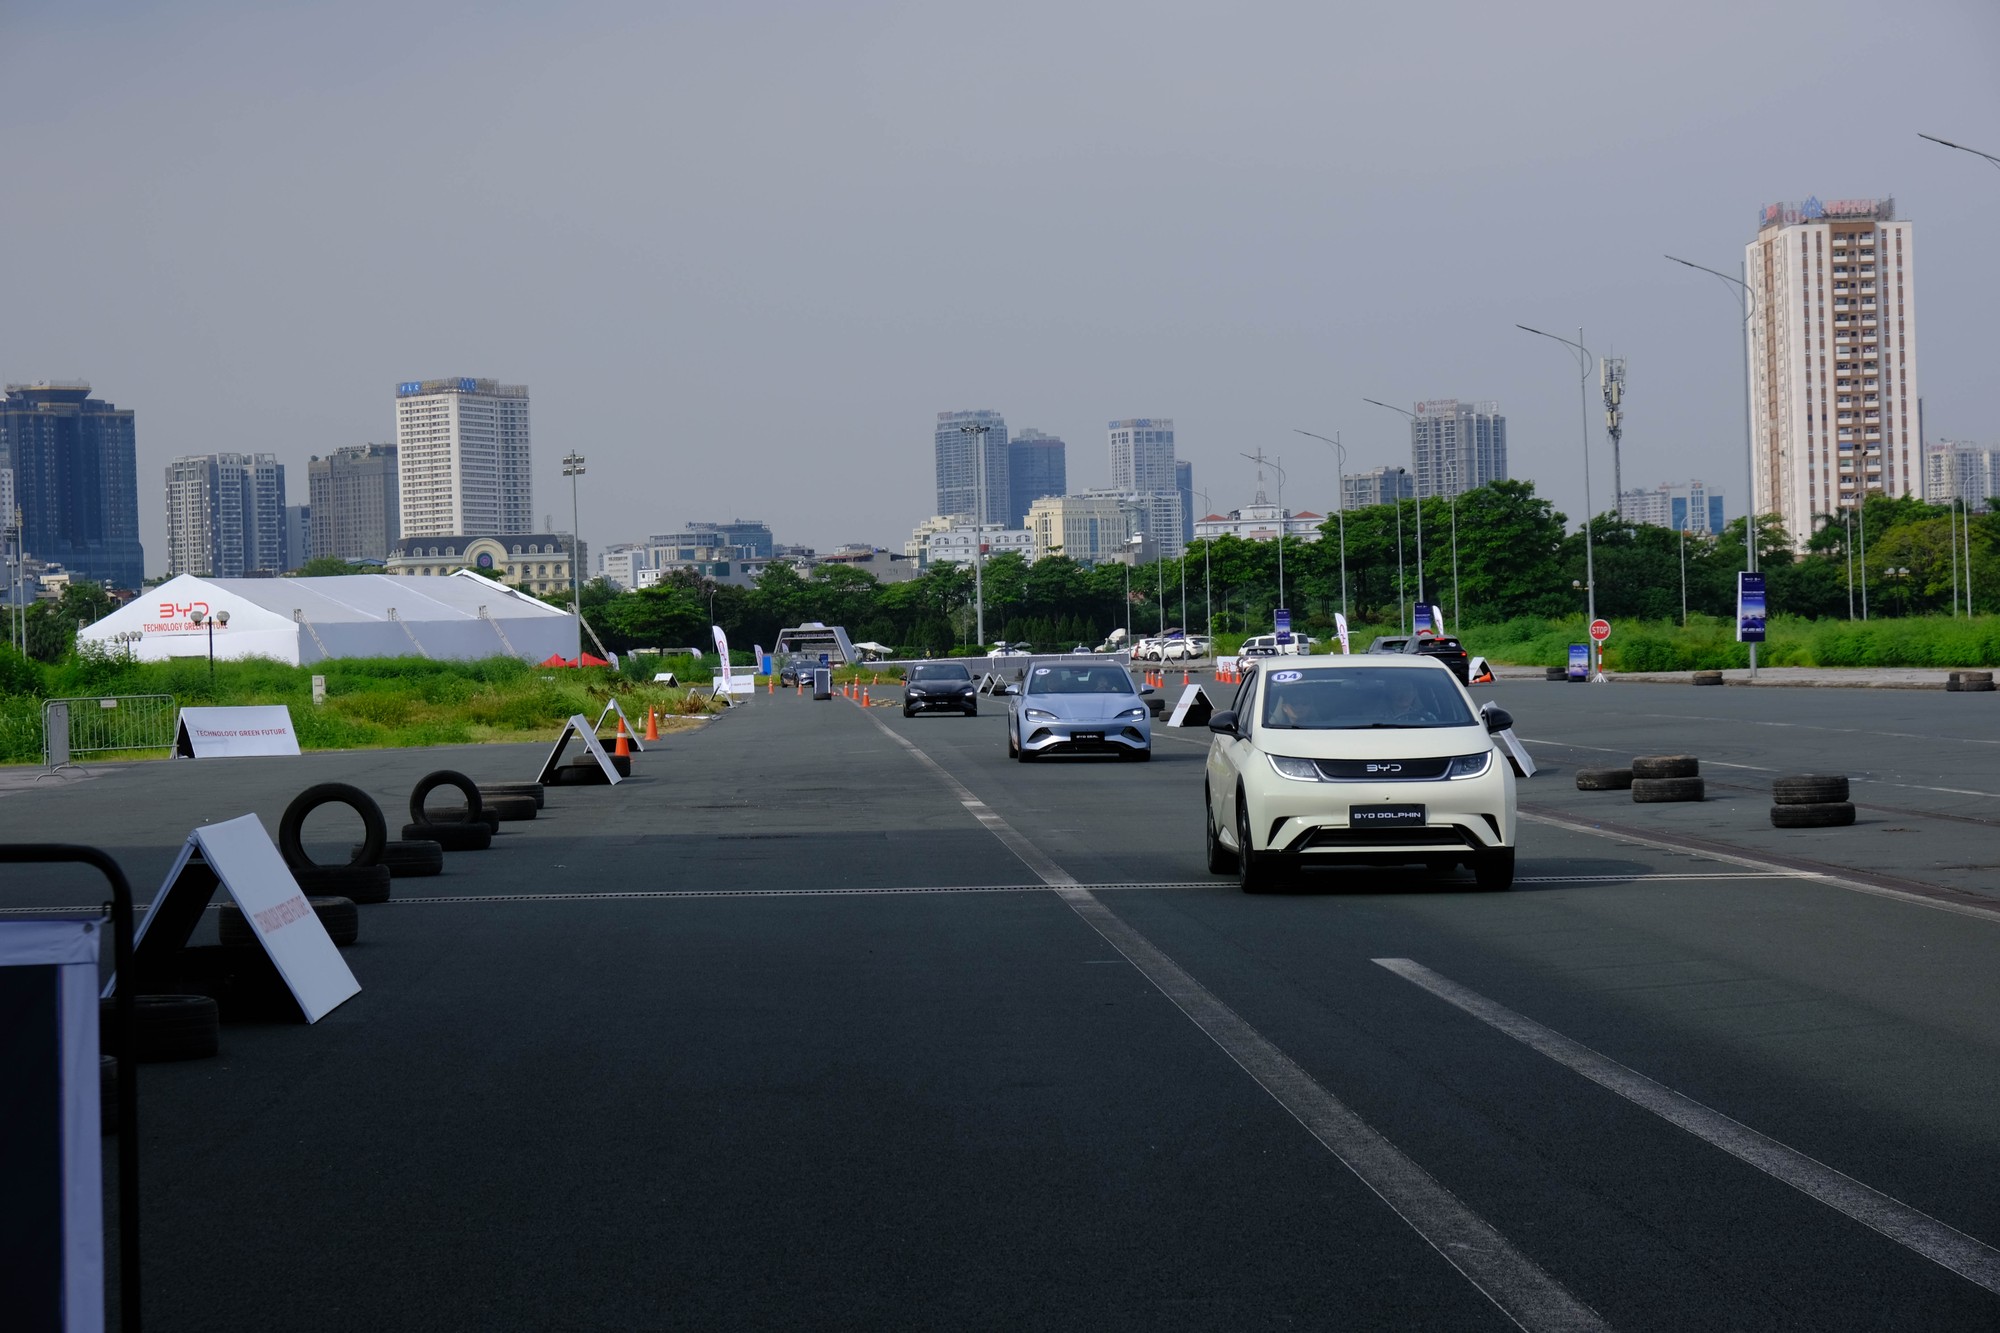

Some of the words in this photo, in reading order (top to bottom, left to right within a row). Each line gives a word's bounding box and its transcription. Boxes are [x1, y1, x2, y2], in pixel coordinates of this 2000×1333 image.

[160, 601, 209, 618] BYD
[143, 623, 182, 632] TECHNOLOGY
[1592, 626, 1608, 634] STOP
[1366, 764, 1402, 772] BYD
